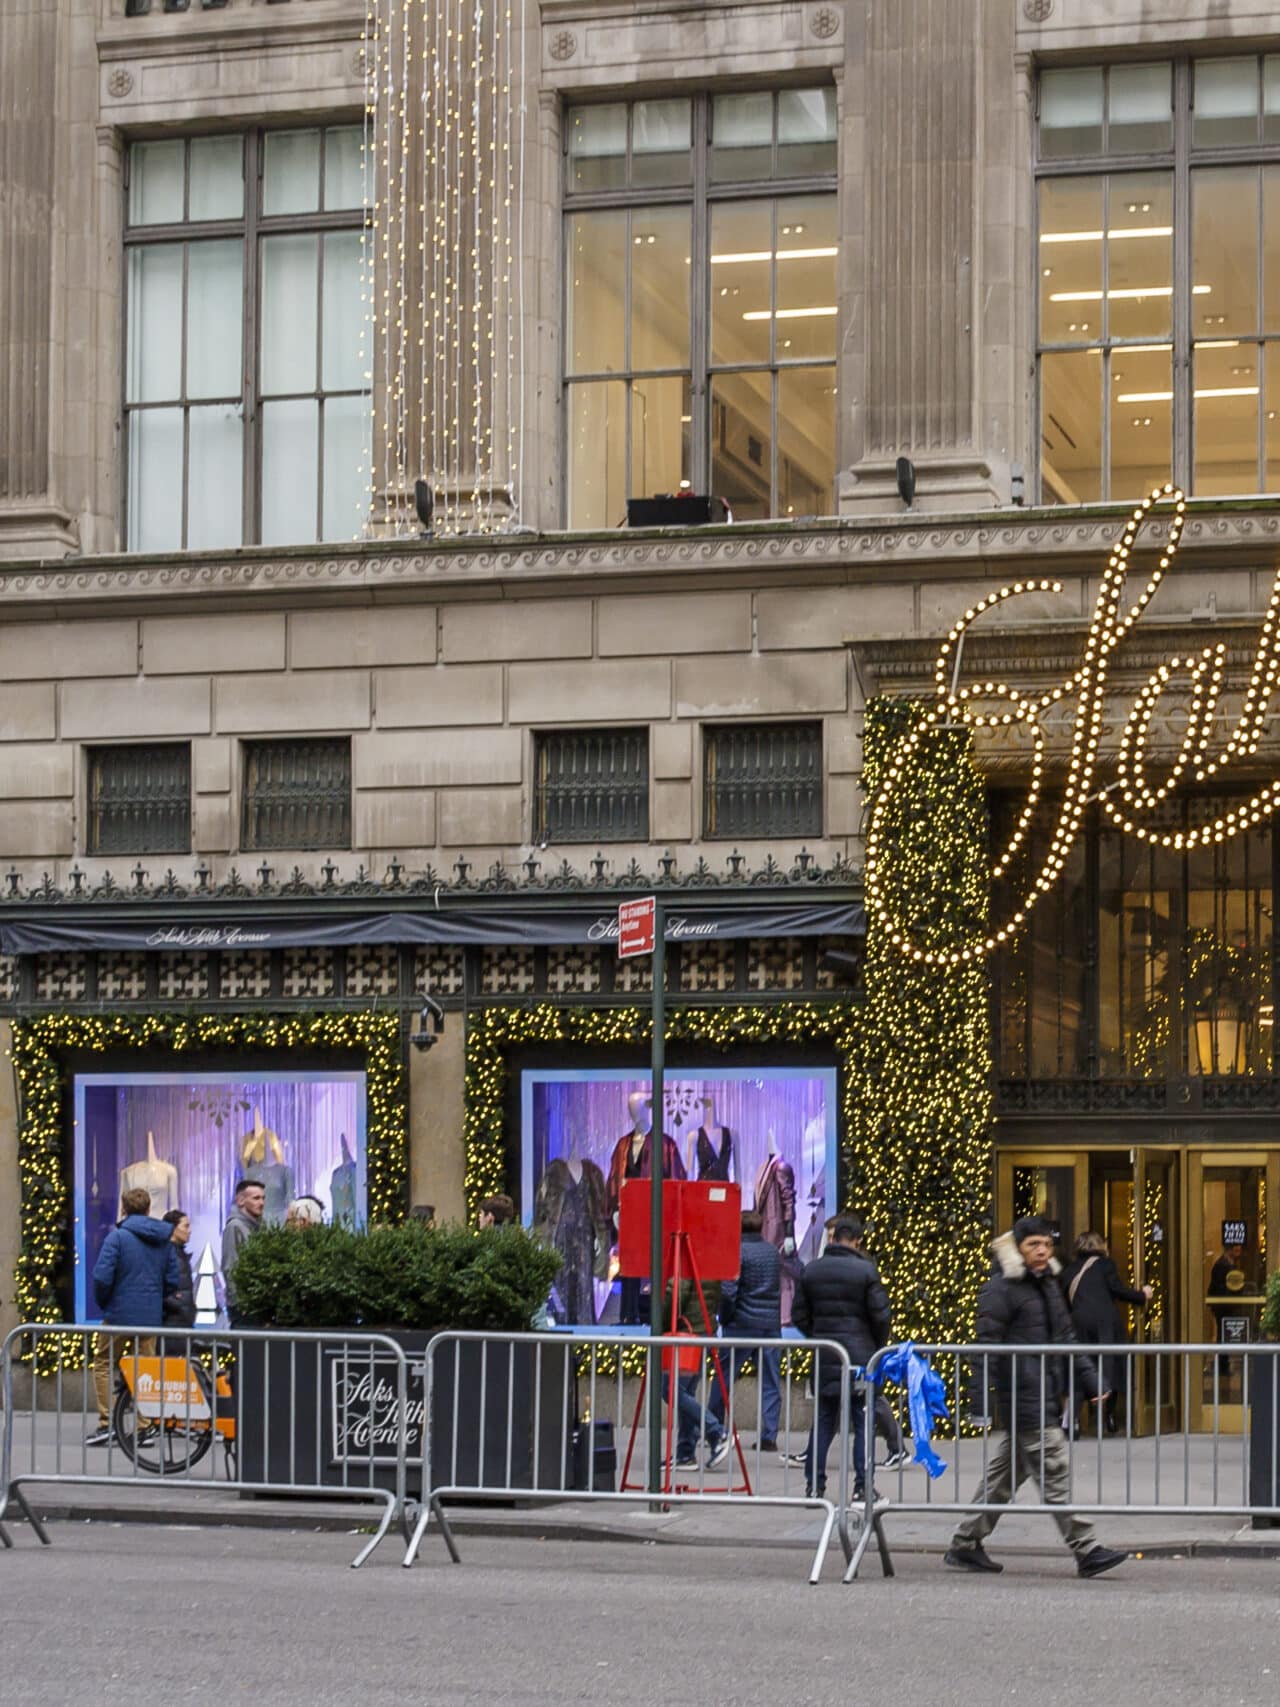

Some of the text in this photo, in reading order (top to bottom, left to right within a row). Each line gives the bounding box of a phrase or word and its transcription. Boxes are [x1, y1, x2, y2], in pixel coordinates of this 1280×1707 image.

[219, 926, 271, 944] Avenue
[664, 916, 719, 938] Avenue
[336, 1371, 394, 1408] Saks
